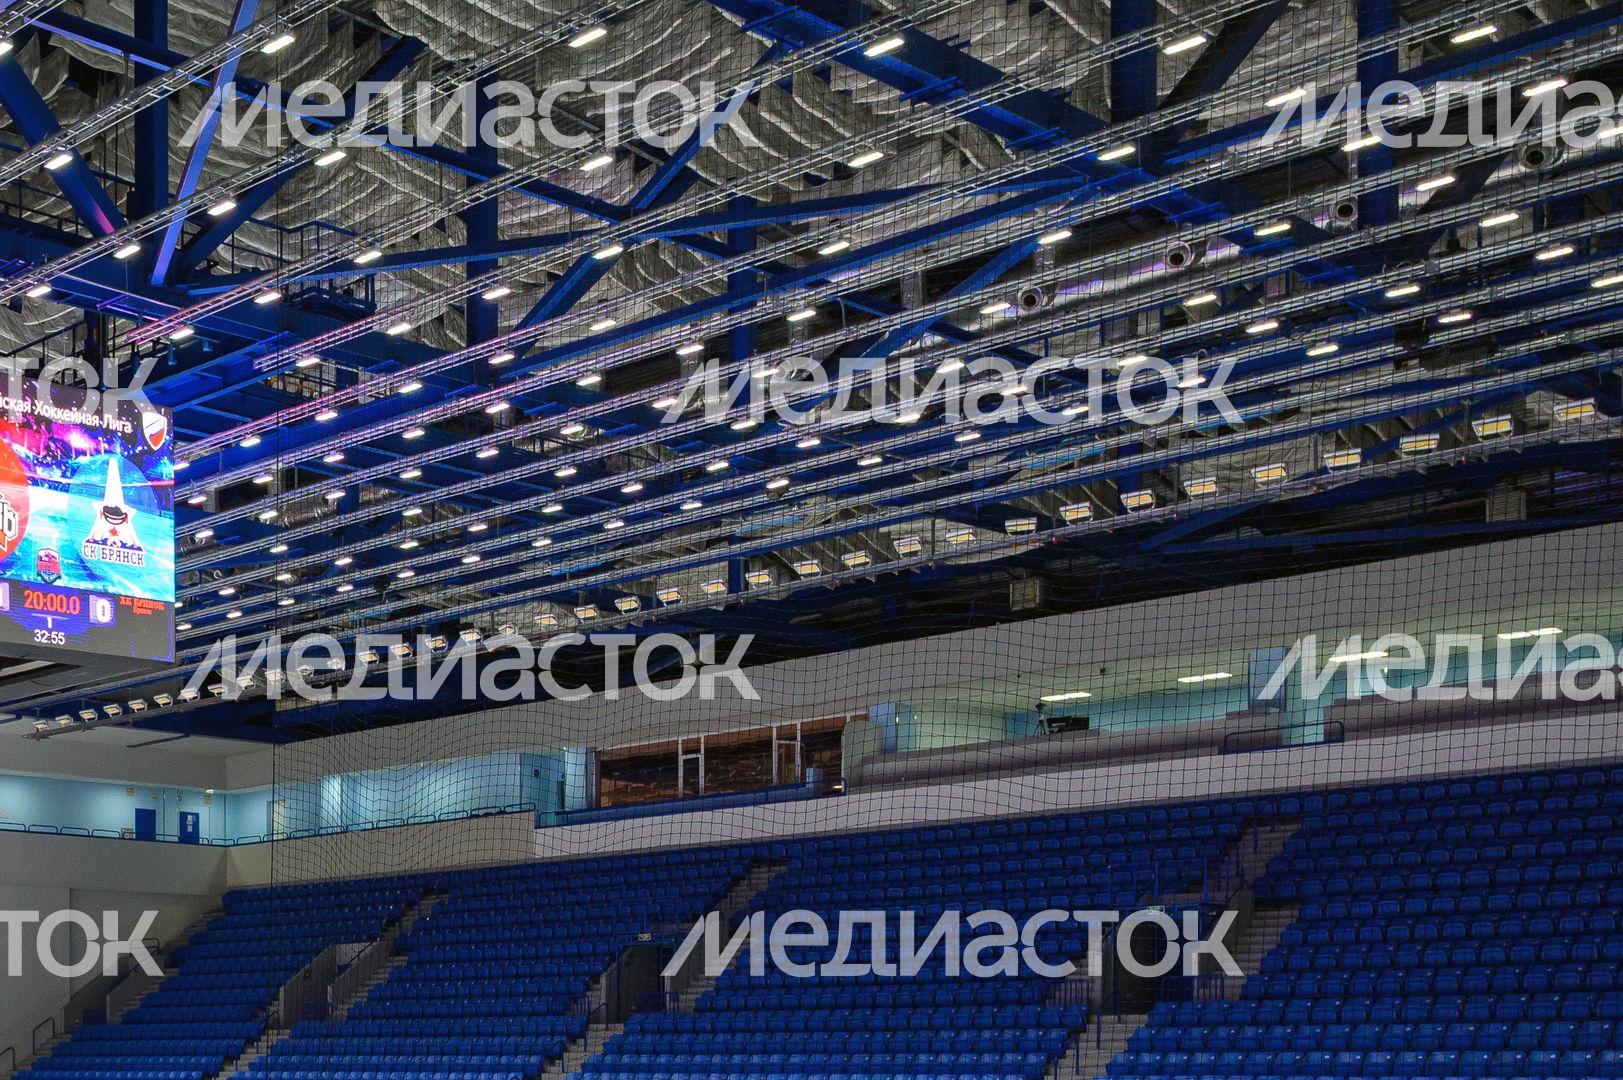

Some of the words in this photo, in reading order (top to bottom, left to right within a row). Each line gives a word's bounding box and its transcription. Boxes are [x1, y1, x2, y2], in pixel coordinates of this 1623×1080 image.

[35, 399, 99, 428] Хоккейная
[103, 415, 133, 434] Лига
[83, 545, 96, 558] СК
[101, 548, 144, 565] БРЯНСК
[23, 590, 81, 615] 20:00.0
[96, 598, 111, 623] 0
[34, 629, 66, 645] 32:55
